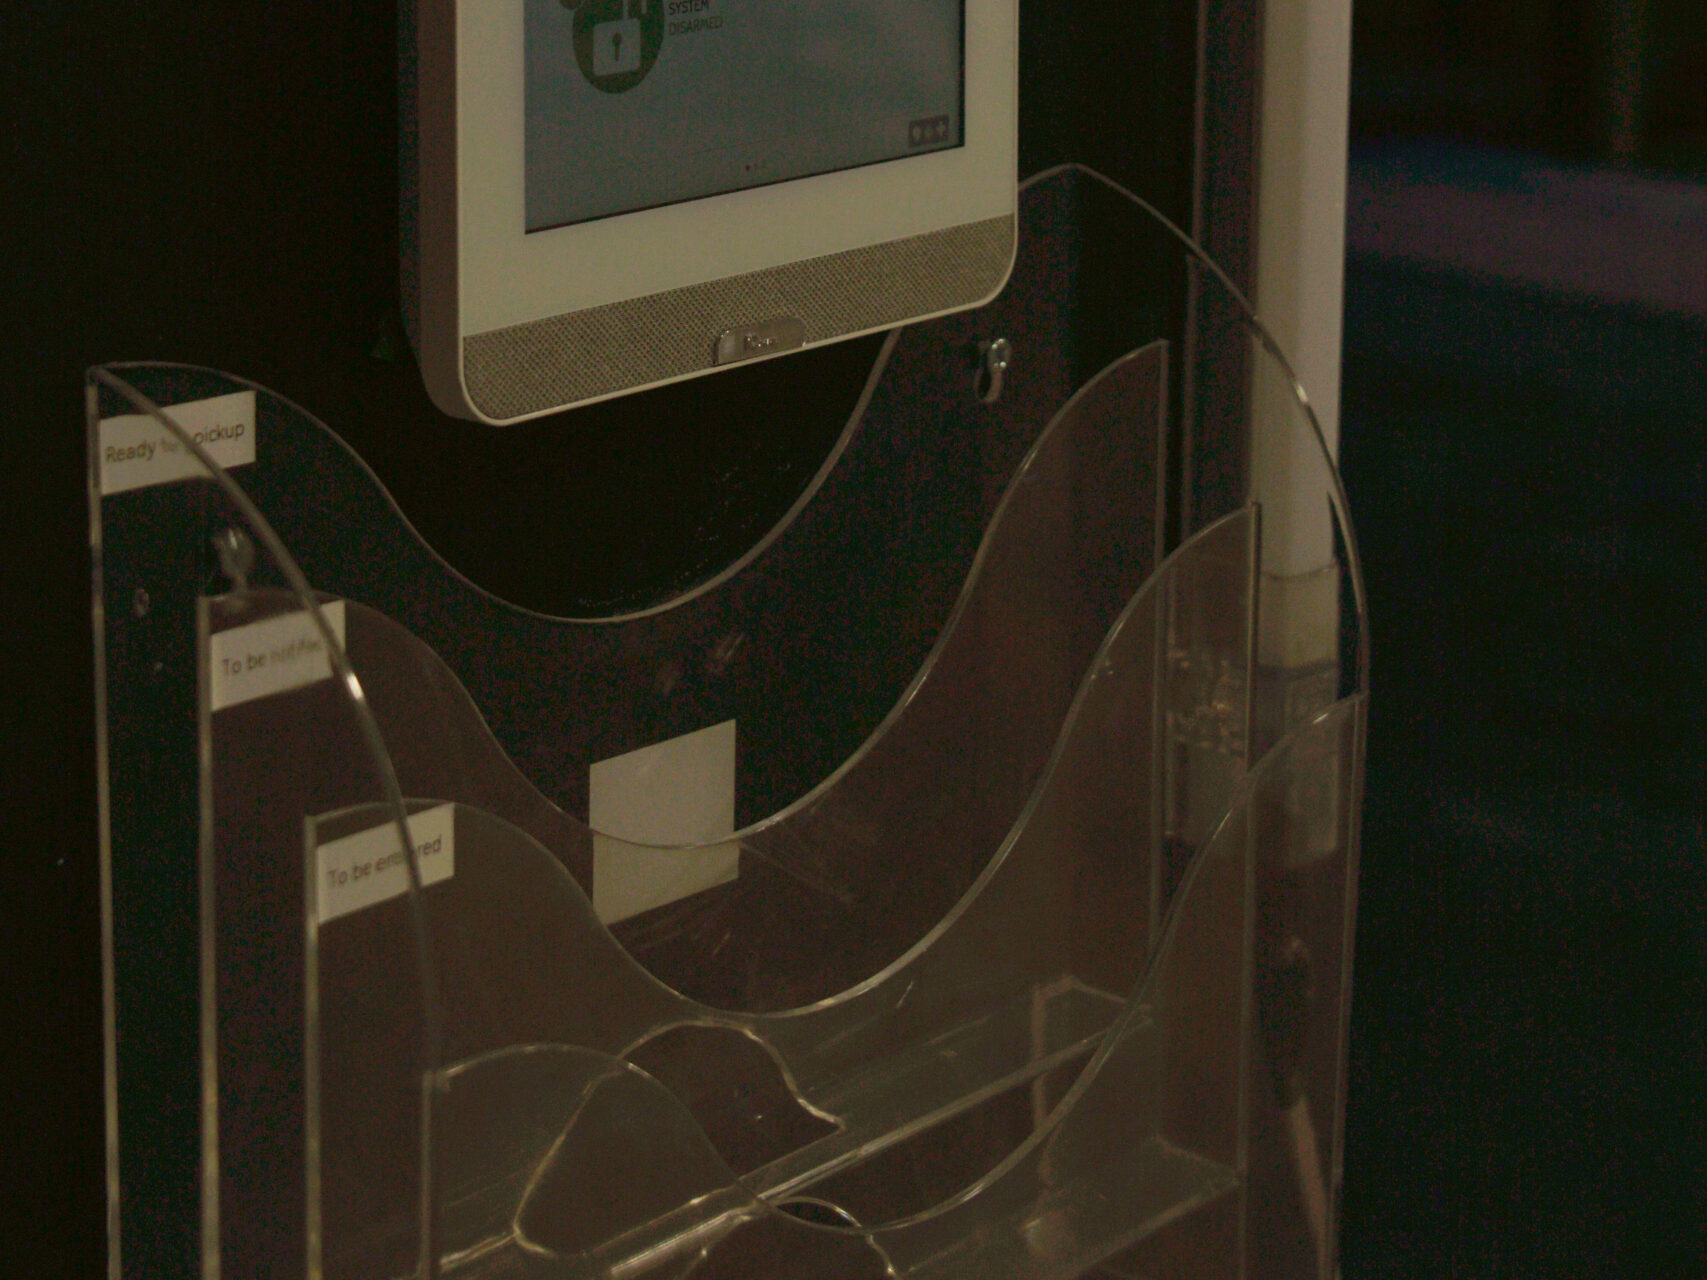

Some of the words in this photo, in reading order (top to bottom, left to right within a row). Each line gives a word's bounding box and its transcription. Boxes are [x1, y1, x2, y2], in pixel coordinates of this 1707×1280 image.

[668, 16, 724, 36] DISARMED
[105, 438, 156, 463] Ready
[222, 656, 242, 677] To
[247, 651, 267, 671] be
[327, 868, 348, 889] To
[352, 862, 372, 881] be
[375, 834, 443, 873] enred
